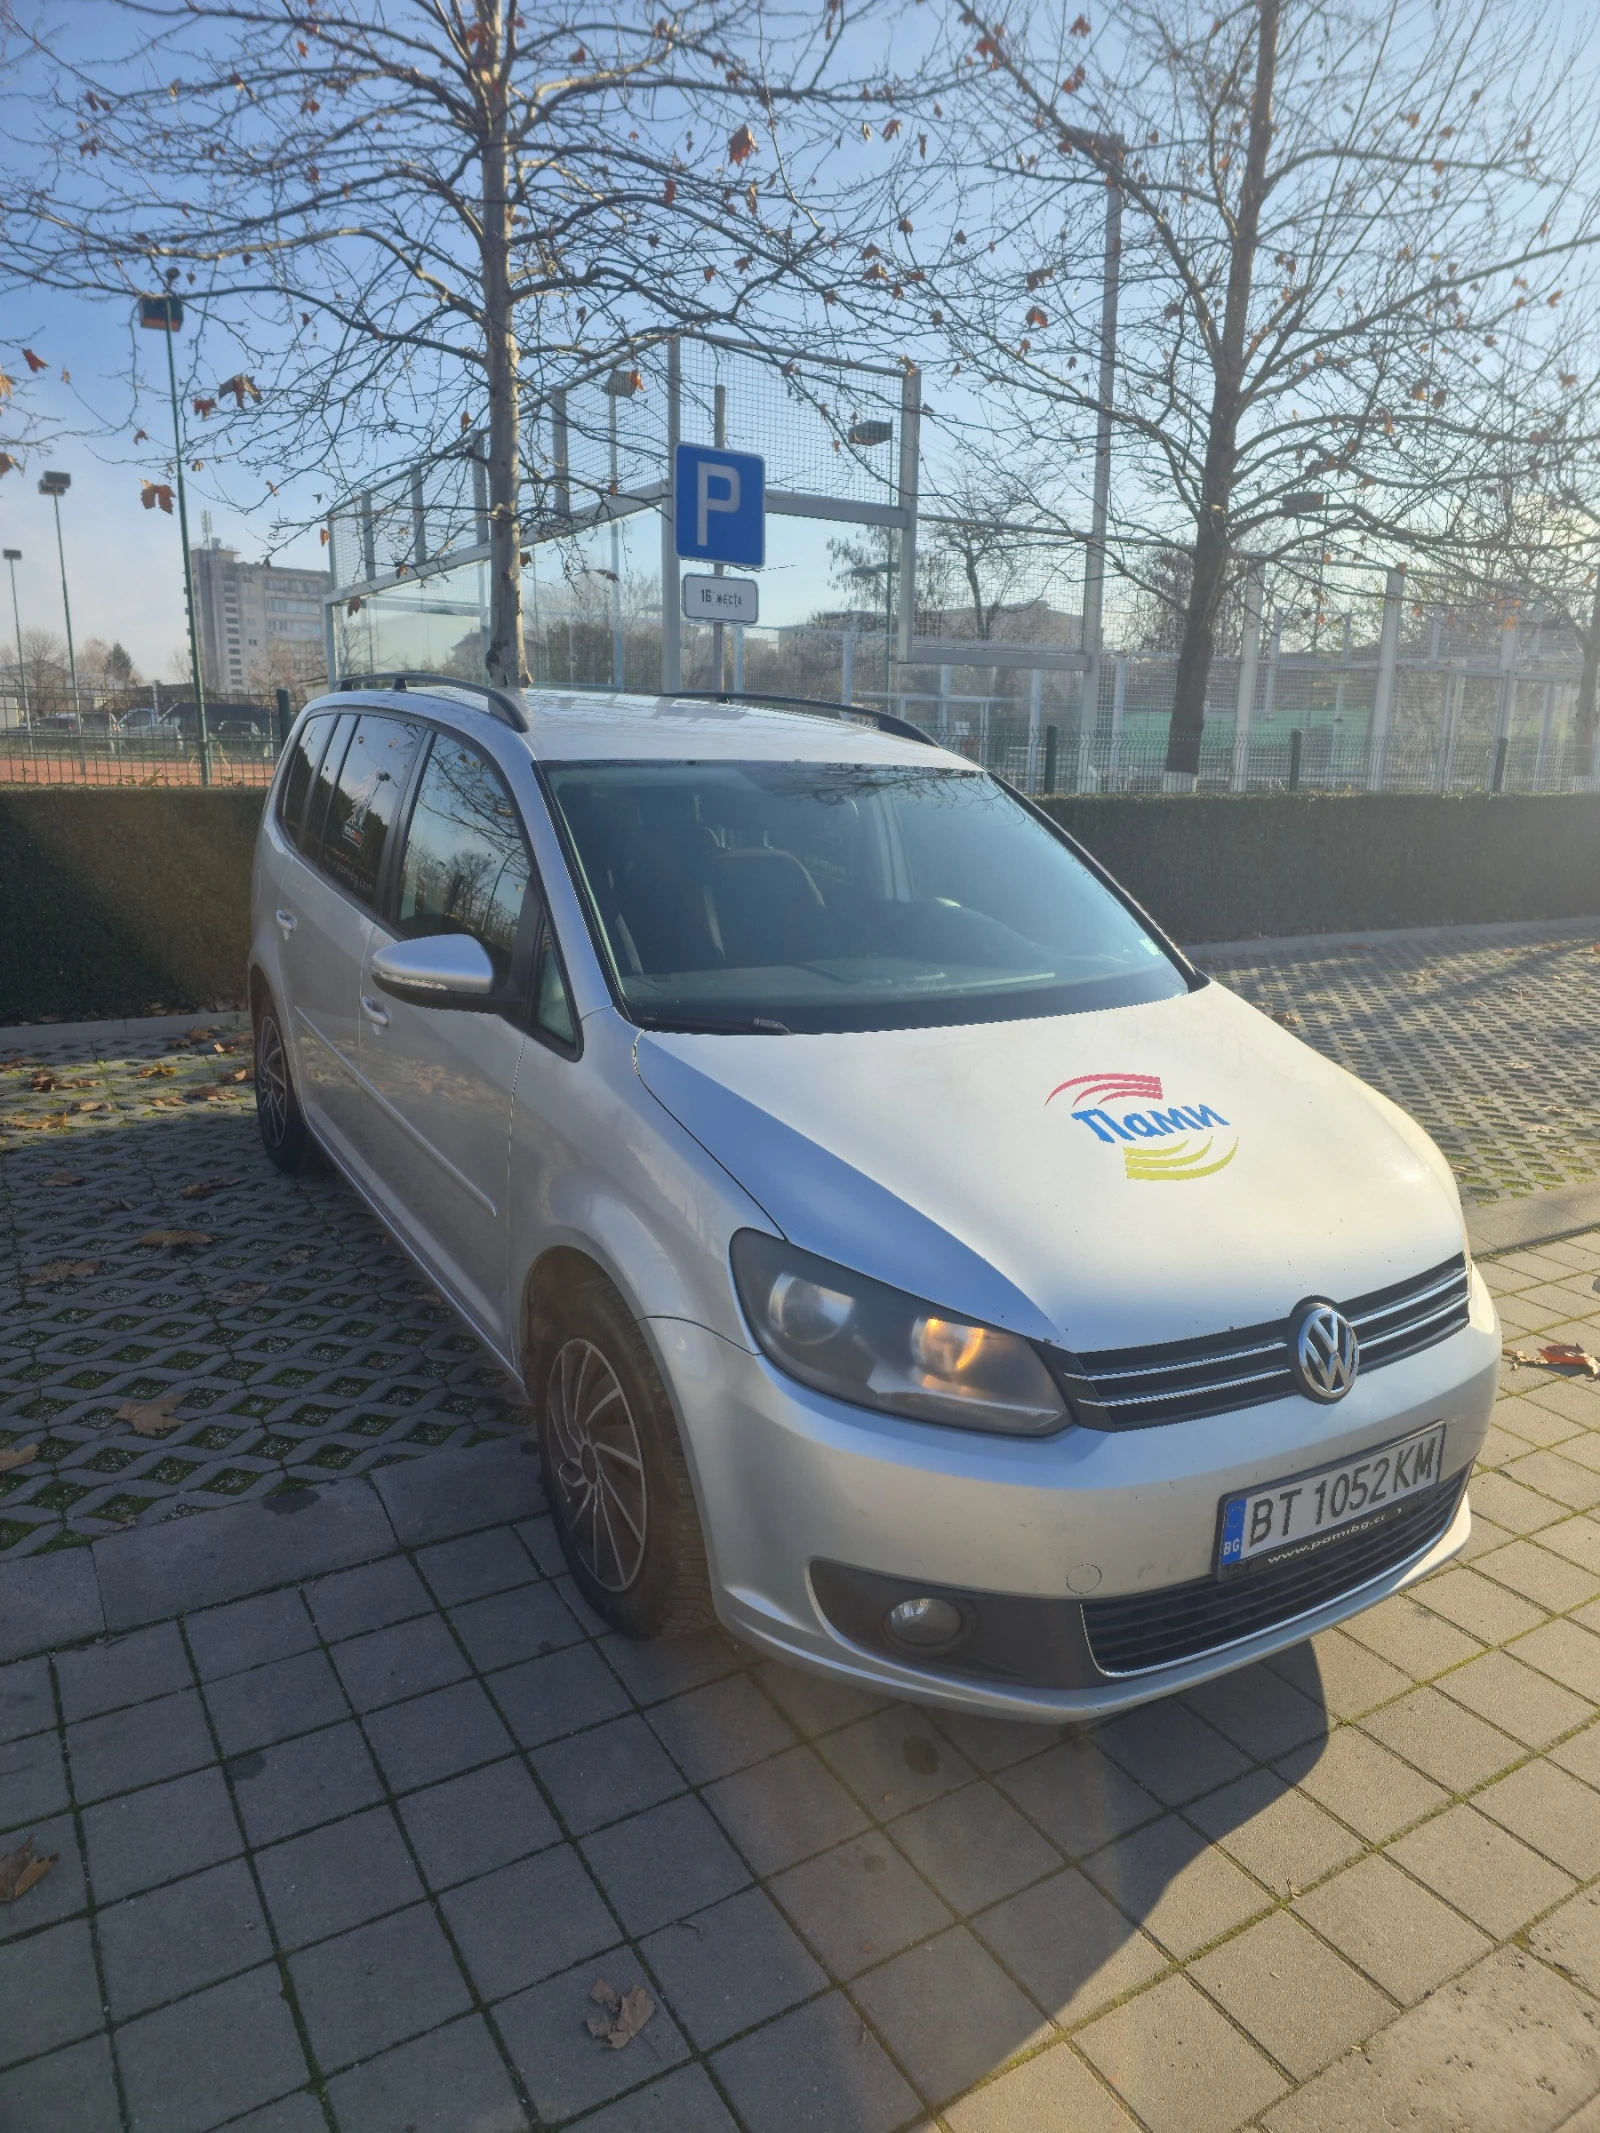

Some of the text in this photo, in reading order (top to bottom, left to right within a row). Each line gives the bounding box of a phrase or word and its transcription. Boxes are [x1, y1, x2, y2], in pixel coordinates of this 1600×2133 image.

[697, 461, 741, 547] P
[701, 589, 712, 603] 16
[1071, 1104, 1230, 1144] Пами
[1223, 1538, 1241, 1556] BG
[1267, 1507, 1402, 1564] www.pamibg.c
